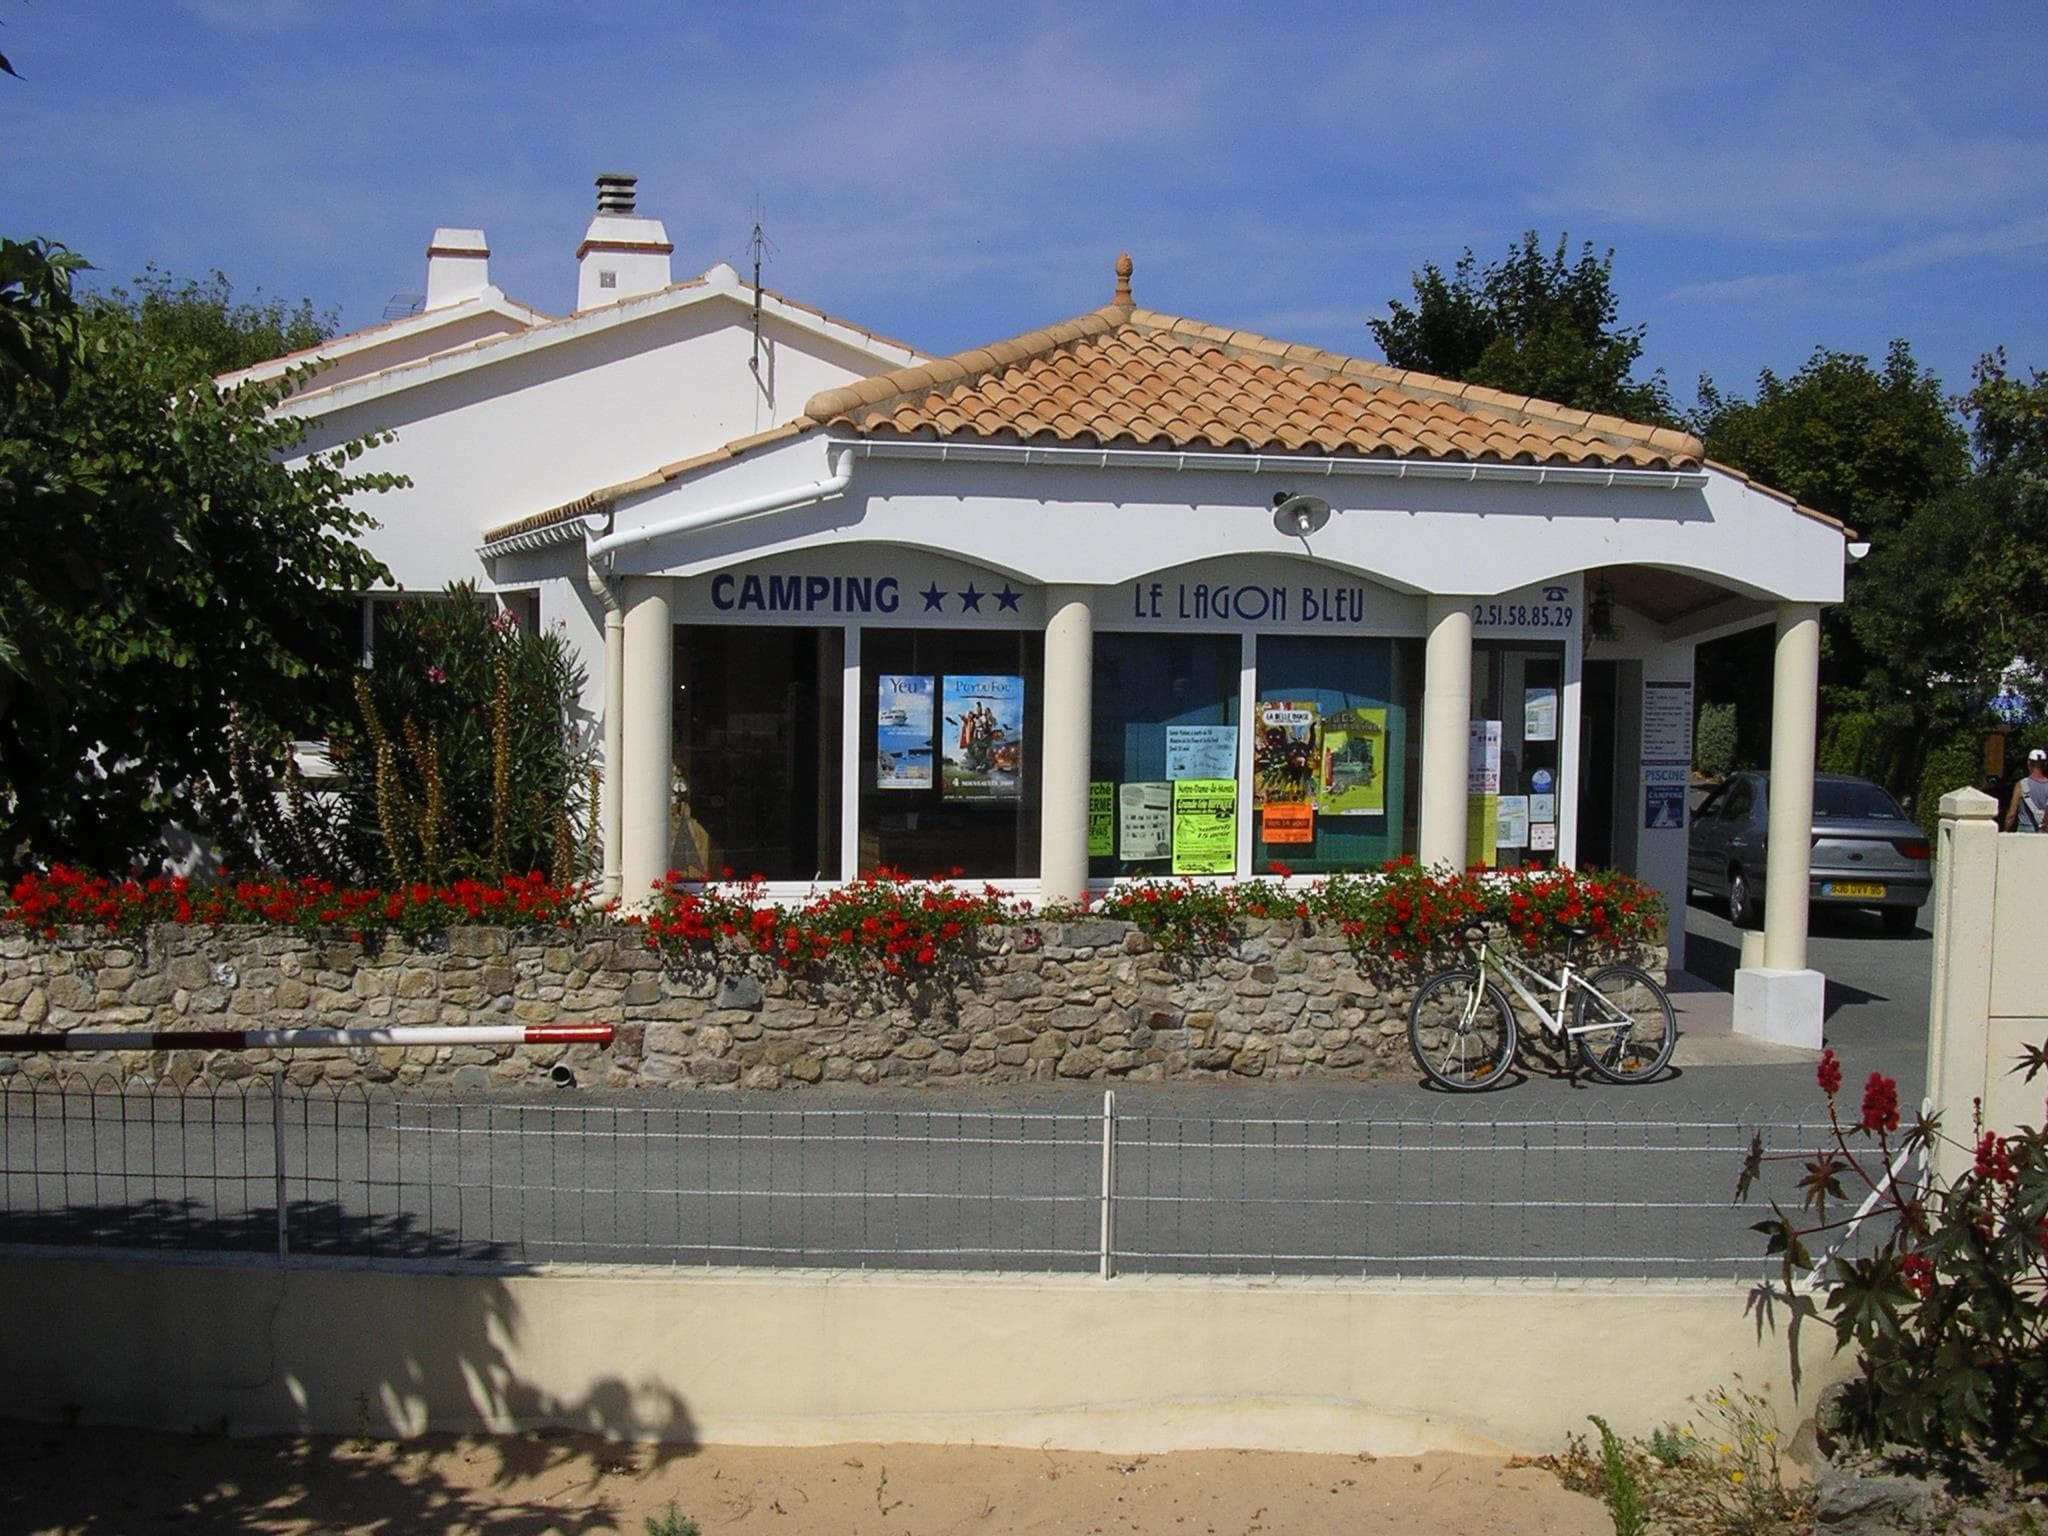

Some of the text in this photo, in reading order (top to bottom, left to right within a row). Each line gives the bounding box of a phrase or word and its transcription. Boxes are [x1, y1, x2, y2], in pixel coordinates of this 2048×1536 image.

[711, 573, 900, 613] CAMPING
[1134, 583, 1364, 623] LE LAGON BLEU
[890, 678, 918, 694] Yeu
[1645, 769, 1687, 781] PISCINE
